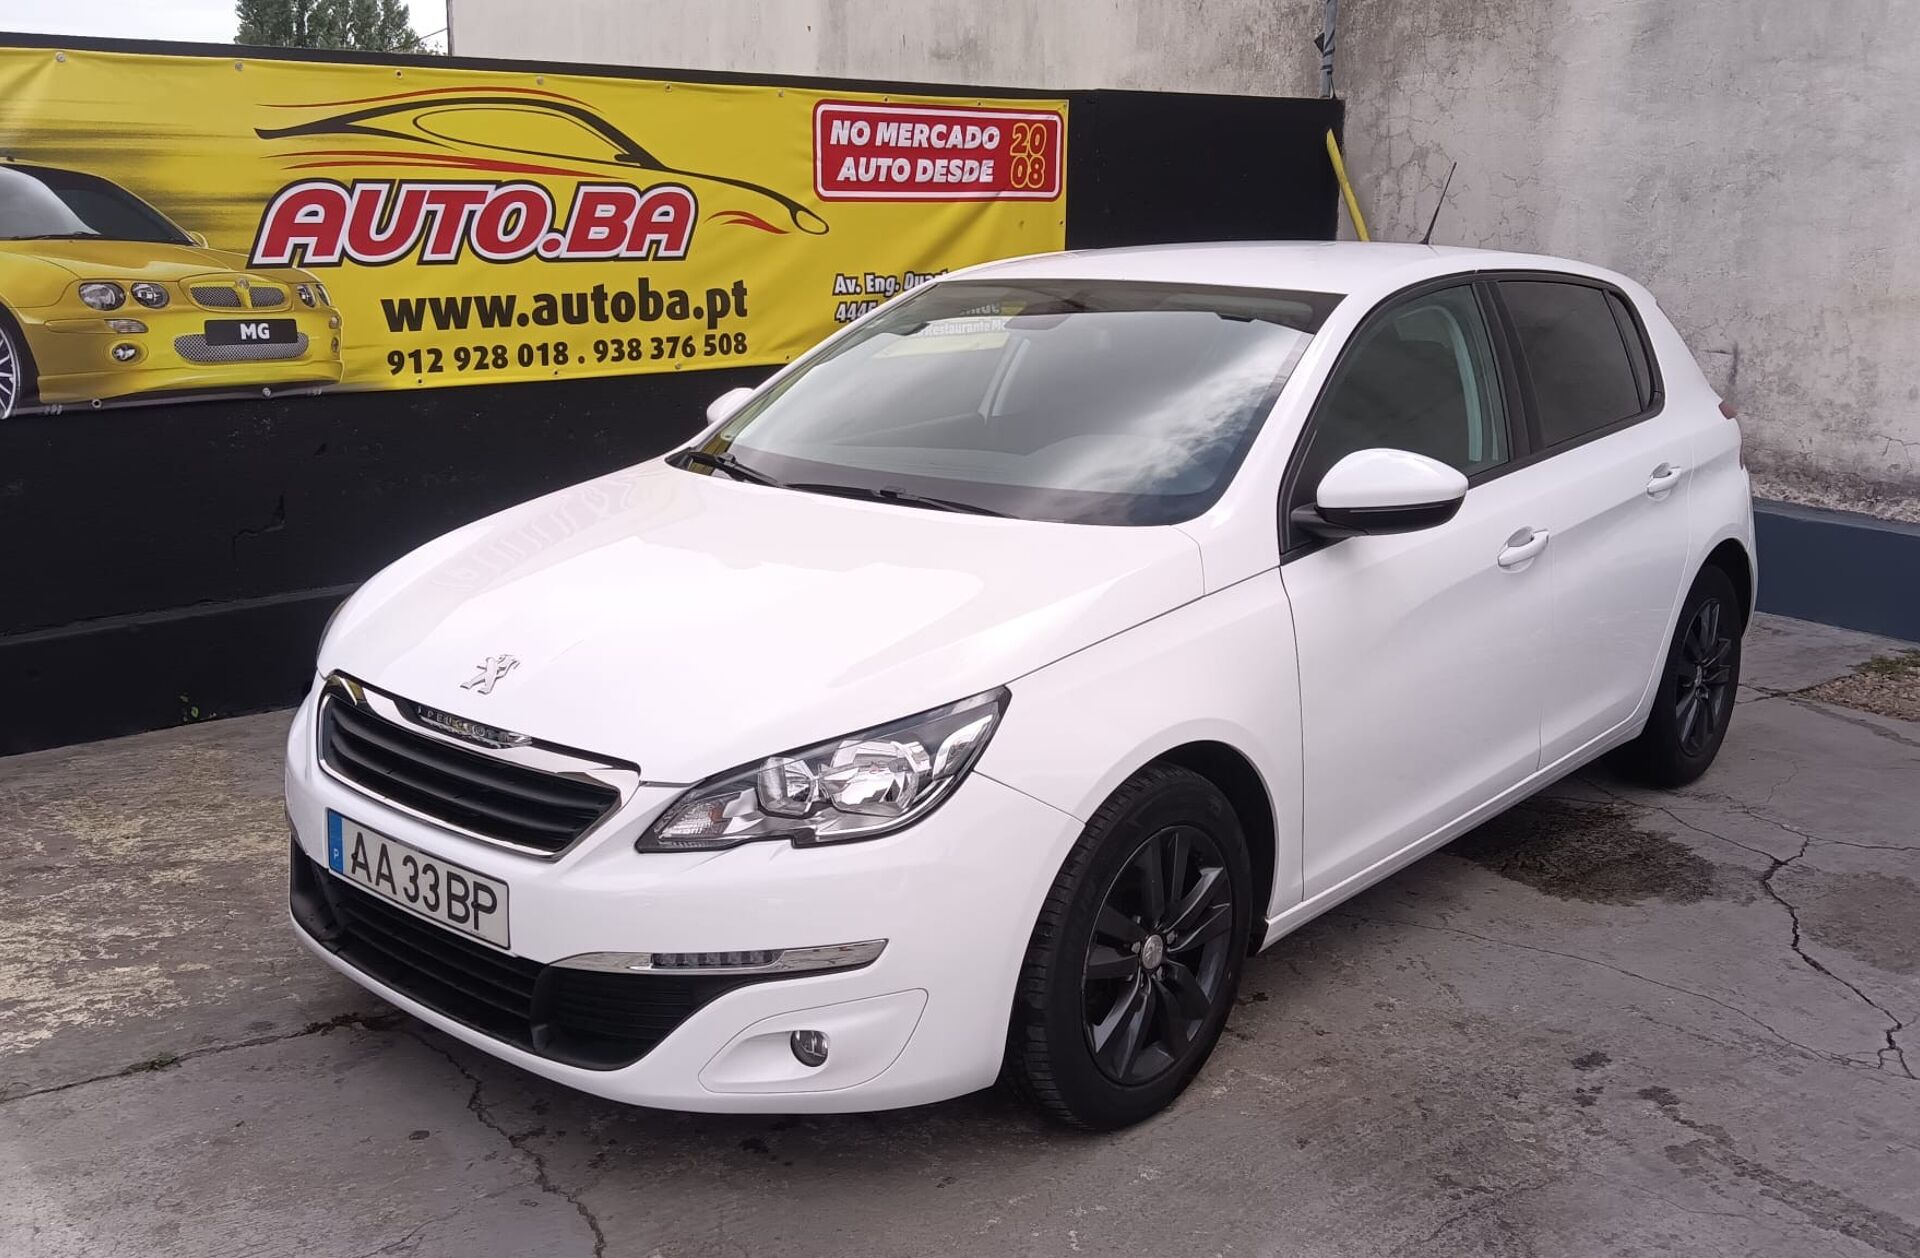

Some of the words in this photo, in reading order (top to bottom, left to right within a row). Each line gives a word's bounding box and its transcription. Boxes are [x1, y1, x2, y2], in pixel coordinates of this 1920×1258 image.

[829, 119, 871, 147] NO
[875, 121, 1001, 150] MERCADO
[1009, 122, 1047, 156] 20
[836, 156, 911, 183] AUTO
[914, 158, 994, 183] DESDE
[1010, 155, 1045, 188] 08
[248, 180, 698, 267] AUTO.BA
[833, 273, 862, 295] Av.
[864, 273, 900, 298] Eng.
[380, 276, 748, 333] www.autoba.pt
[239, 322, 271, 341] MG
[387, 348, 443, 376] 912
[454, 345, 509, 372] 928
[517, 341, 569, 367] 018
[593, 338, 642, 363] 938
[650, 335, 696, 360] 376
[703, 332, 748, 357] 508
